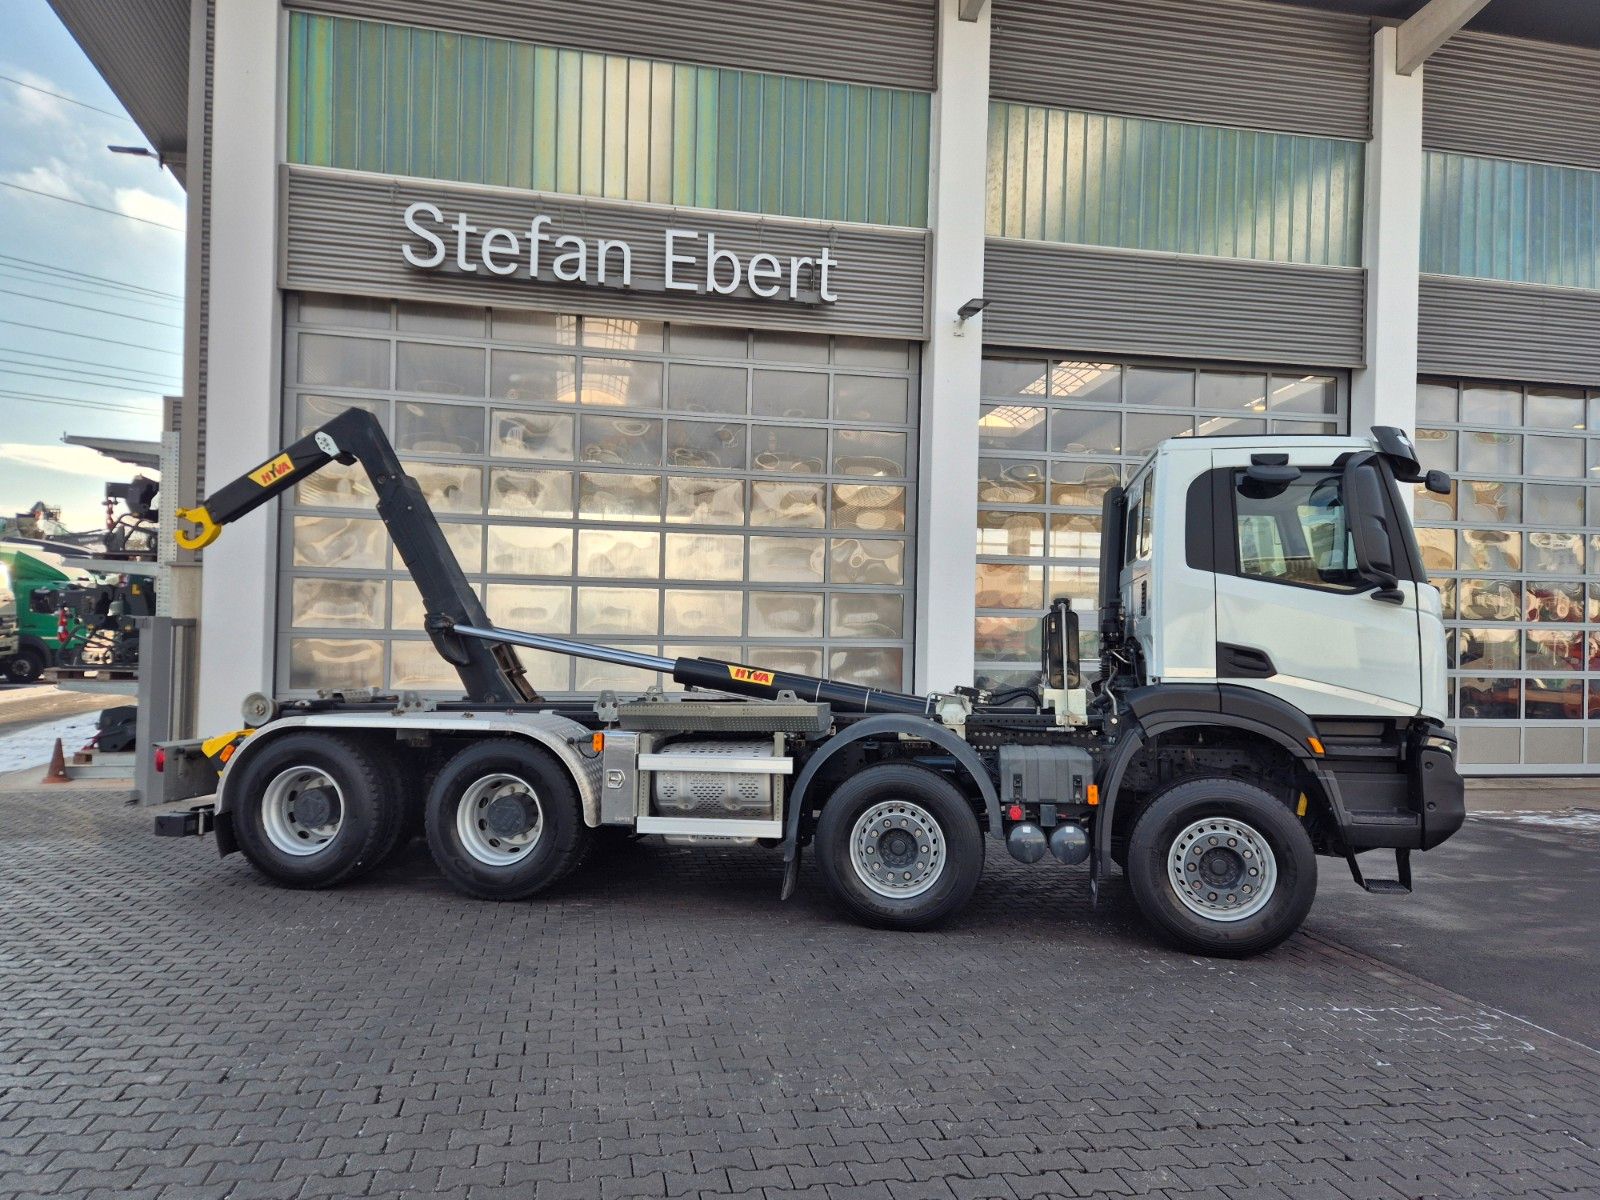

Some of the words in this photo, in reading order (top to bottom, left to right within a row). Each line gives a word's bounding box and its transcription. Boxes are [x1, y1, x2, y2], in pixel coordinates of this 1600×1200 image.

[401, 201, 631, 286] Stefan
[664, 229, 838, 301] Ebert
[261, 463, 291, 484] HYVA
[735, 668, 769, 682] HYVA
